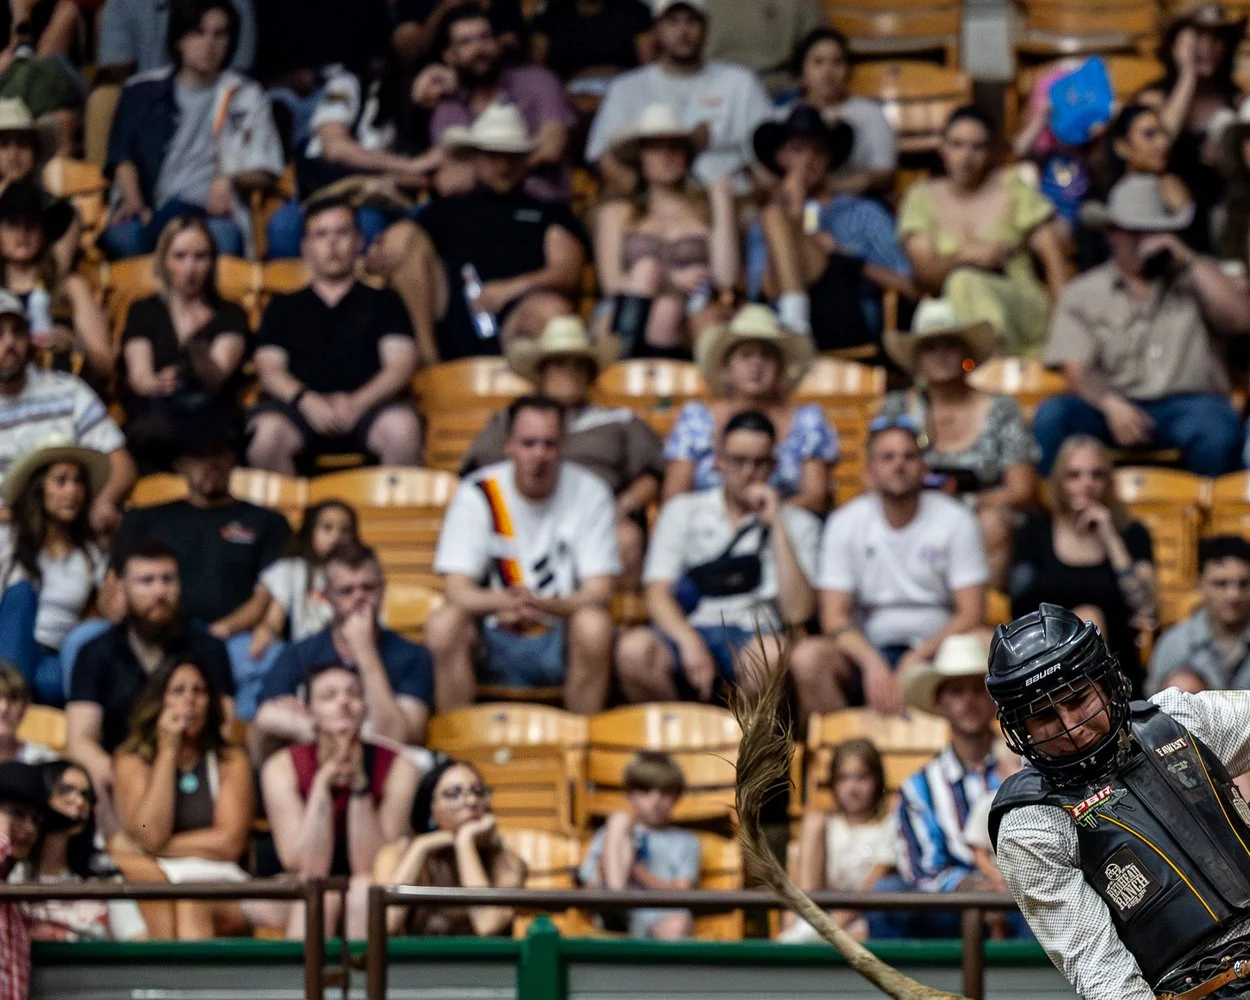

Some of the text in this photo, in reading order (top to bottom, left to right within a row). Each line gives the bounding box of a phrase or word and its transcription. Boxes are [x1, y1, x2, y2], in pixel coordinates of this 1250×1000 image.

[1025, 662, 1062, 687] BAUER
[1072, 785, 1111, 817] PBR
[1107, 864, 1142, 902] REDHEAD
[1114, 874, 1150, 911] RANCH
